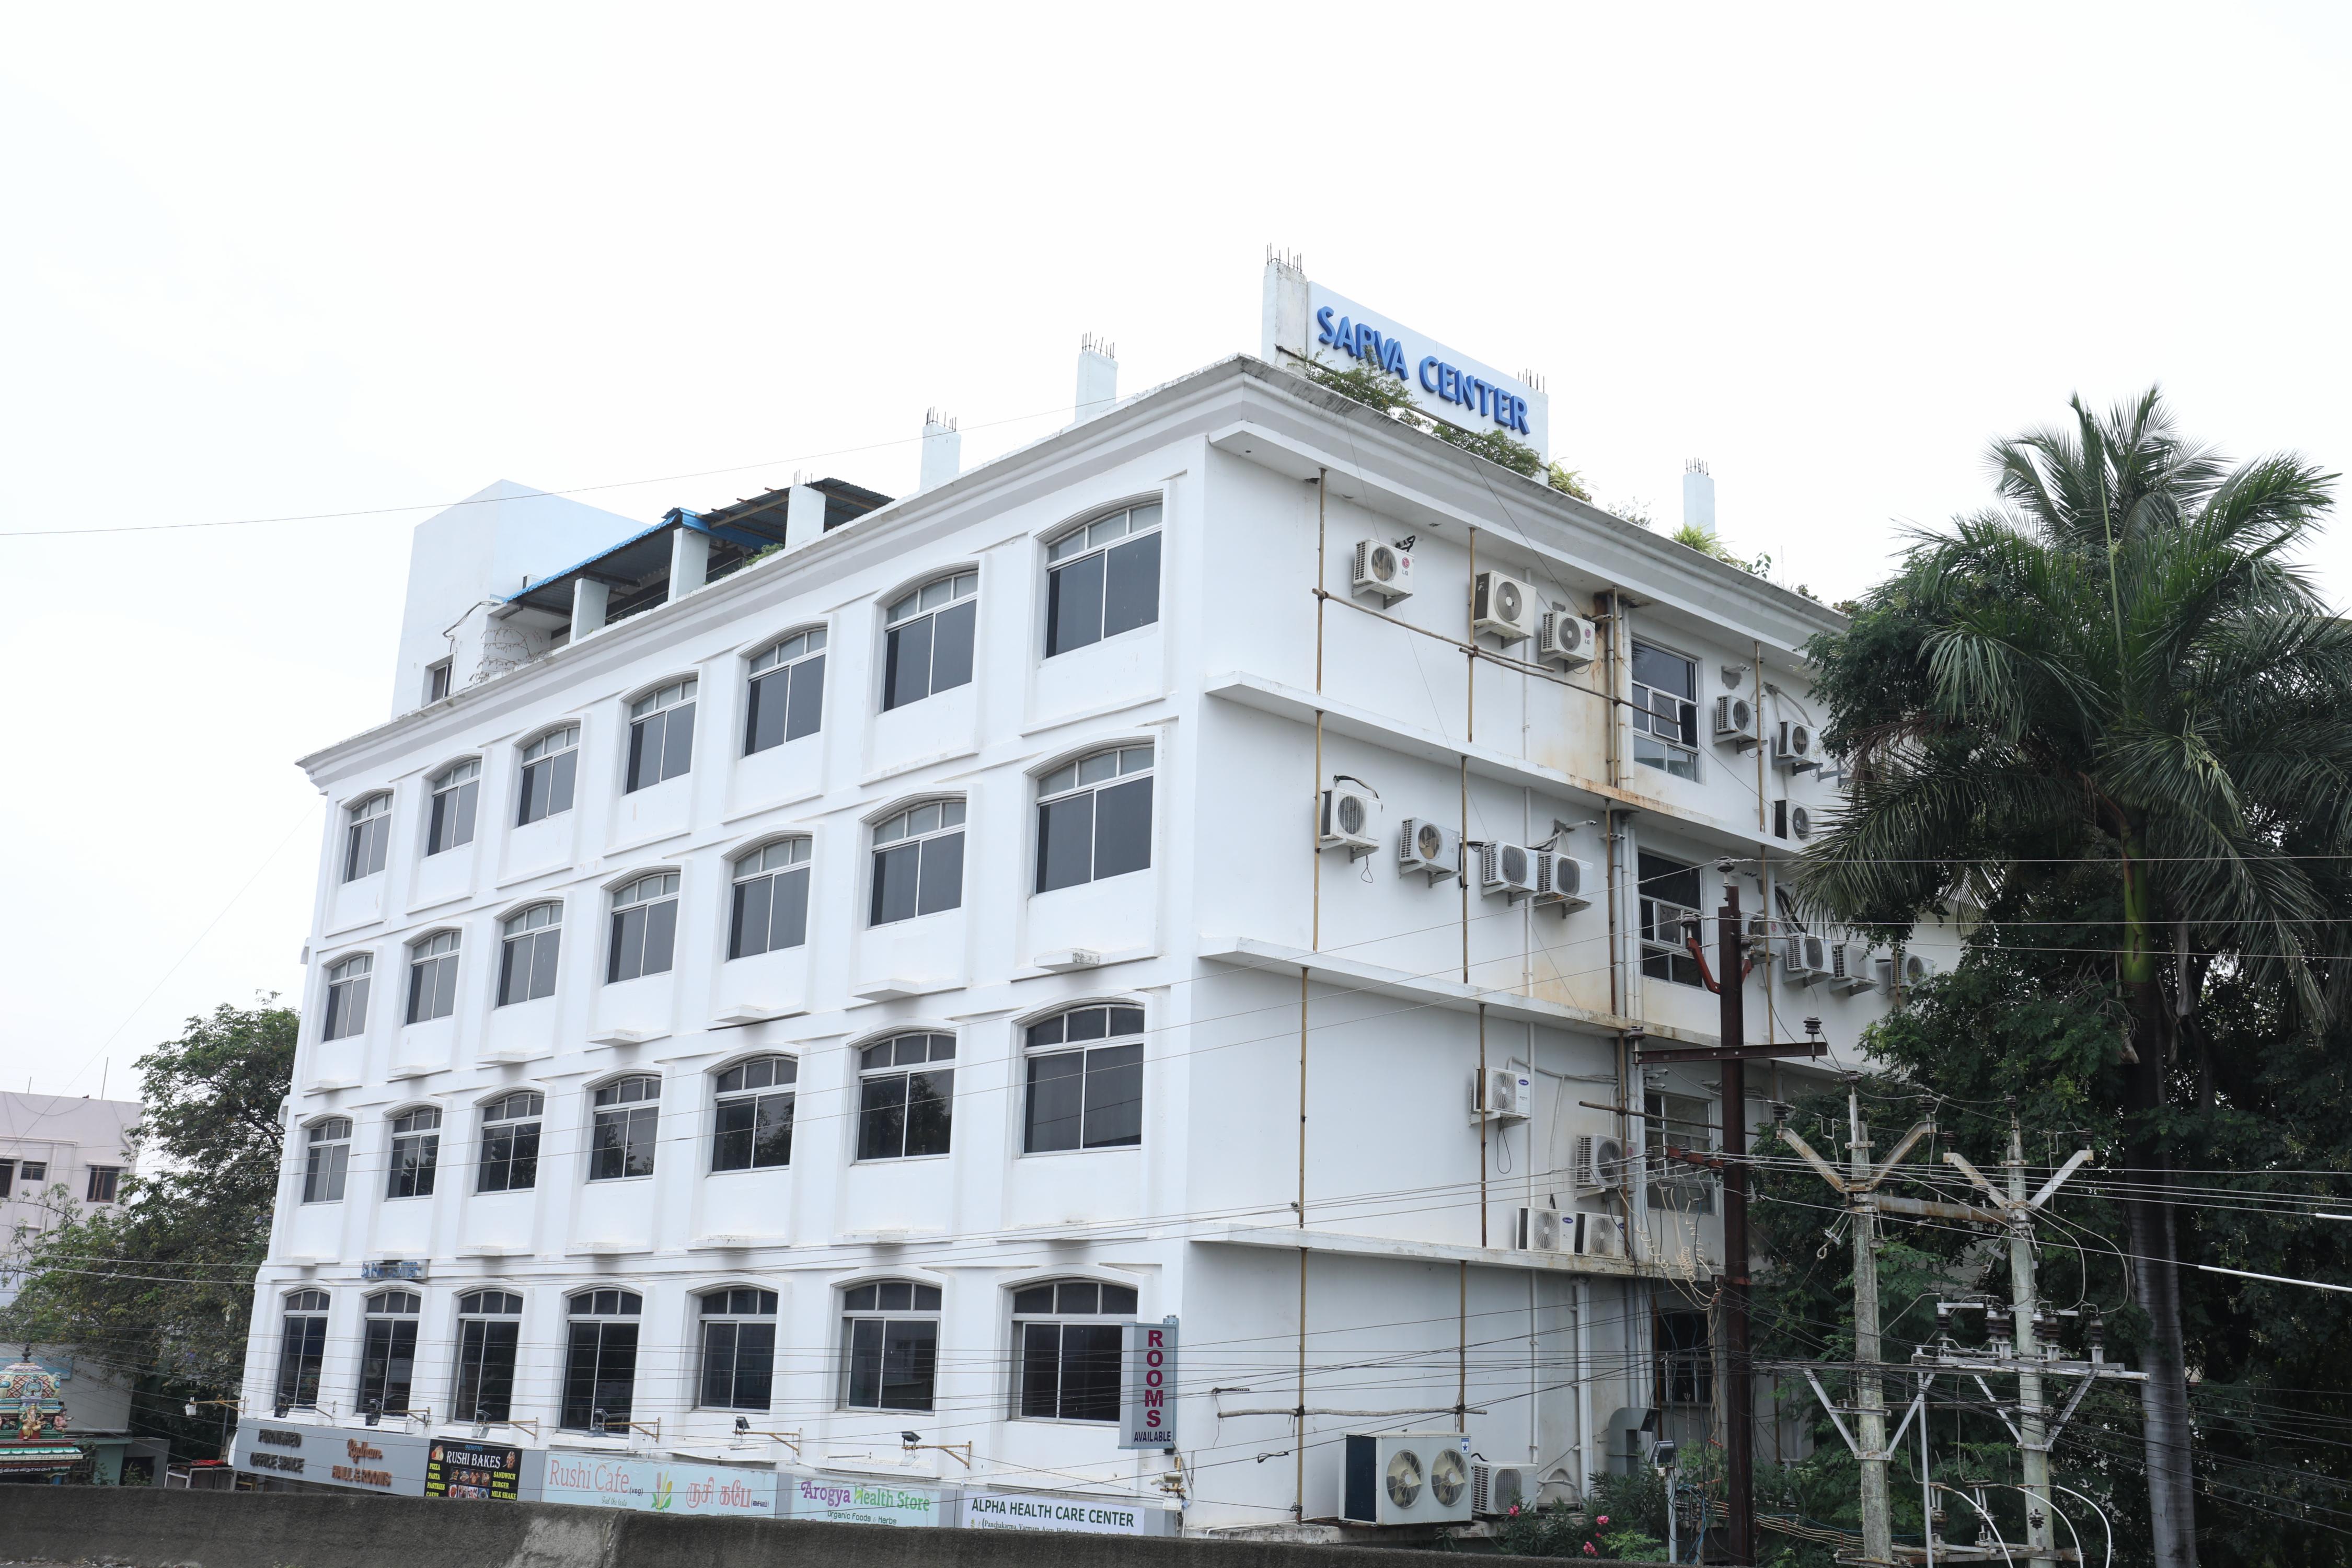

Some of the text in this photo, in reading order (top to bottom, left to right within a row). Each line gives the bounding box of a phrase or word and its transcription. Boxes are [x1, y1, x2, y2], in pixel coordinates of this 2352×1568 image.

[1317, 306, 1530, 435] SARVA CENTER
[1145, 1330, 1164, 1427] ROOMS
[258, 1429, 302, 1447] FURNISHED
[1134, 1431, 1171, 1443] AVAILABLE
[250, 1451, 305, 1473] OFFICE SPACE
[446, 1451, 501, 1469] RUSHI BAKES
[331, 1465, 353, 1482] HALL
[361, 1469, 392, 1487] ROOMS
[492, 1481, 509, 1489] BURGER
[493, 1471, 516, 1480] SANDWICH
[549, 1459, 643, 1496] Rushi Cafe (veg)
[427, 1482, 445, 1491] PASTRIES
[502, 1491, 516, 1500] SHAKE
[686, 1477, 714, 1508] ருசி
[719, 1479, 752, 1508] கபே
[801, 1481, 930, 1512] Arogya Health Store
[827, 1510, 850, 1519] Organic
[852, 1513, 871, 1522] Foods
[878, 1516, 897, 1525] Herbs
[972, 1498, 1134, 1527] ALPHA HEALTH CARE CENTER
